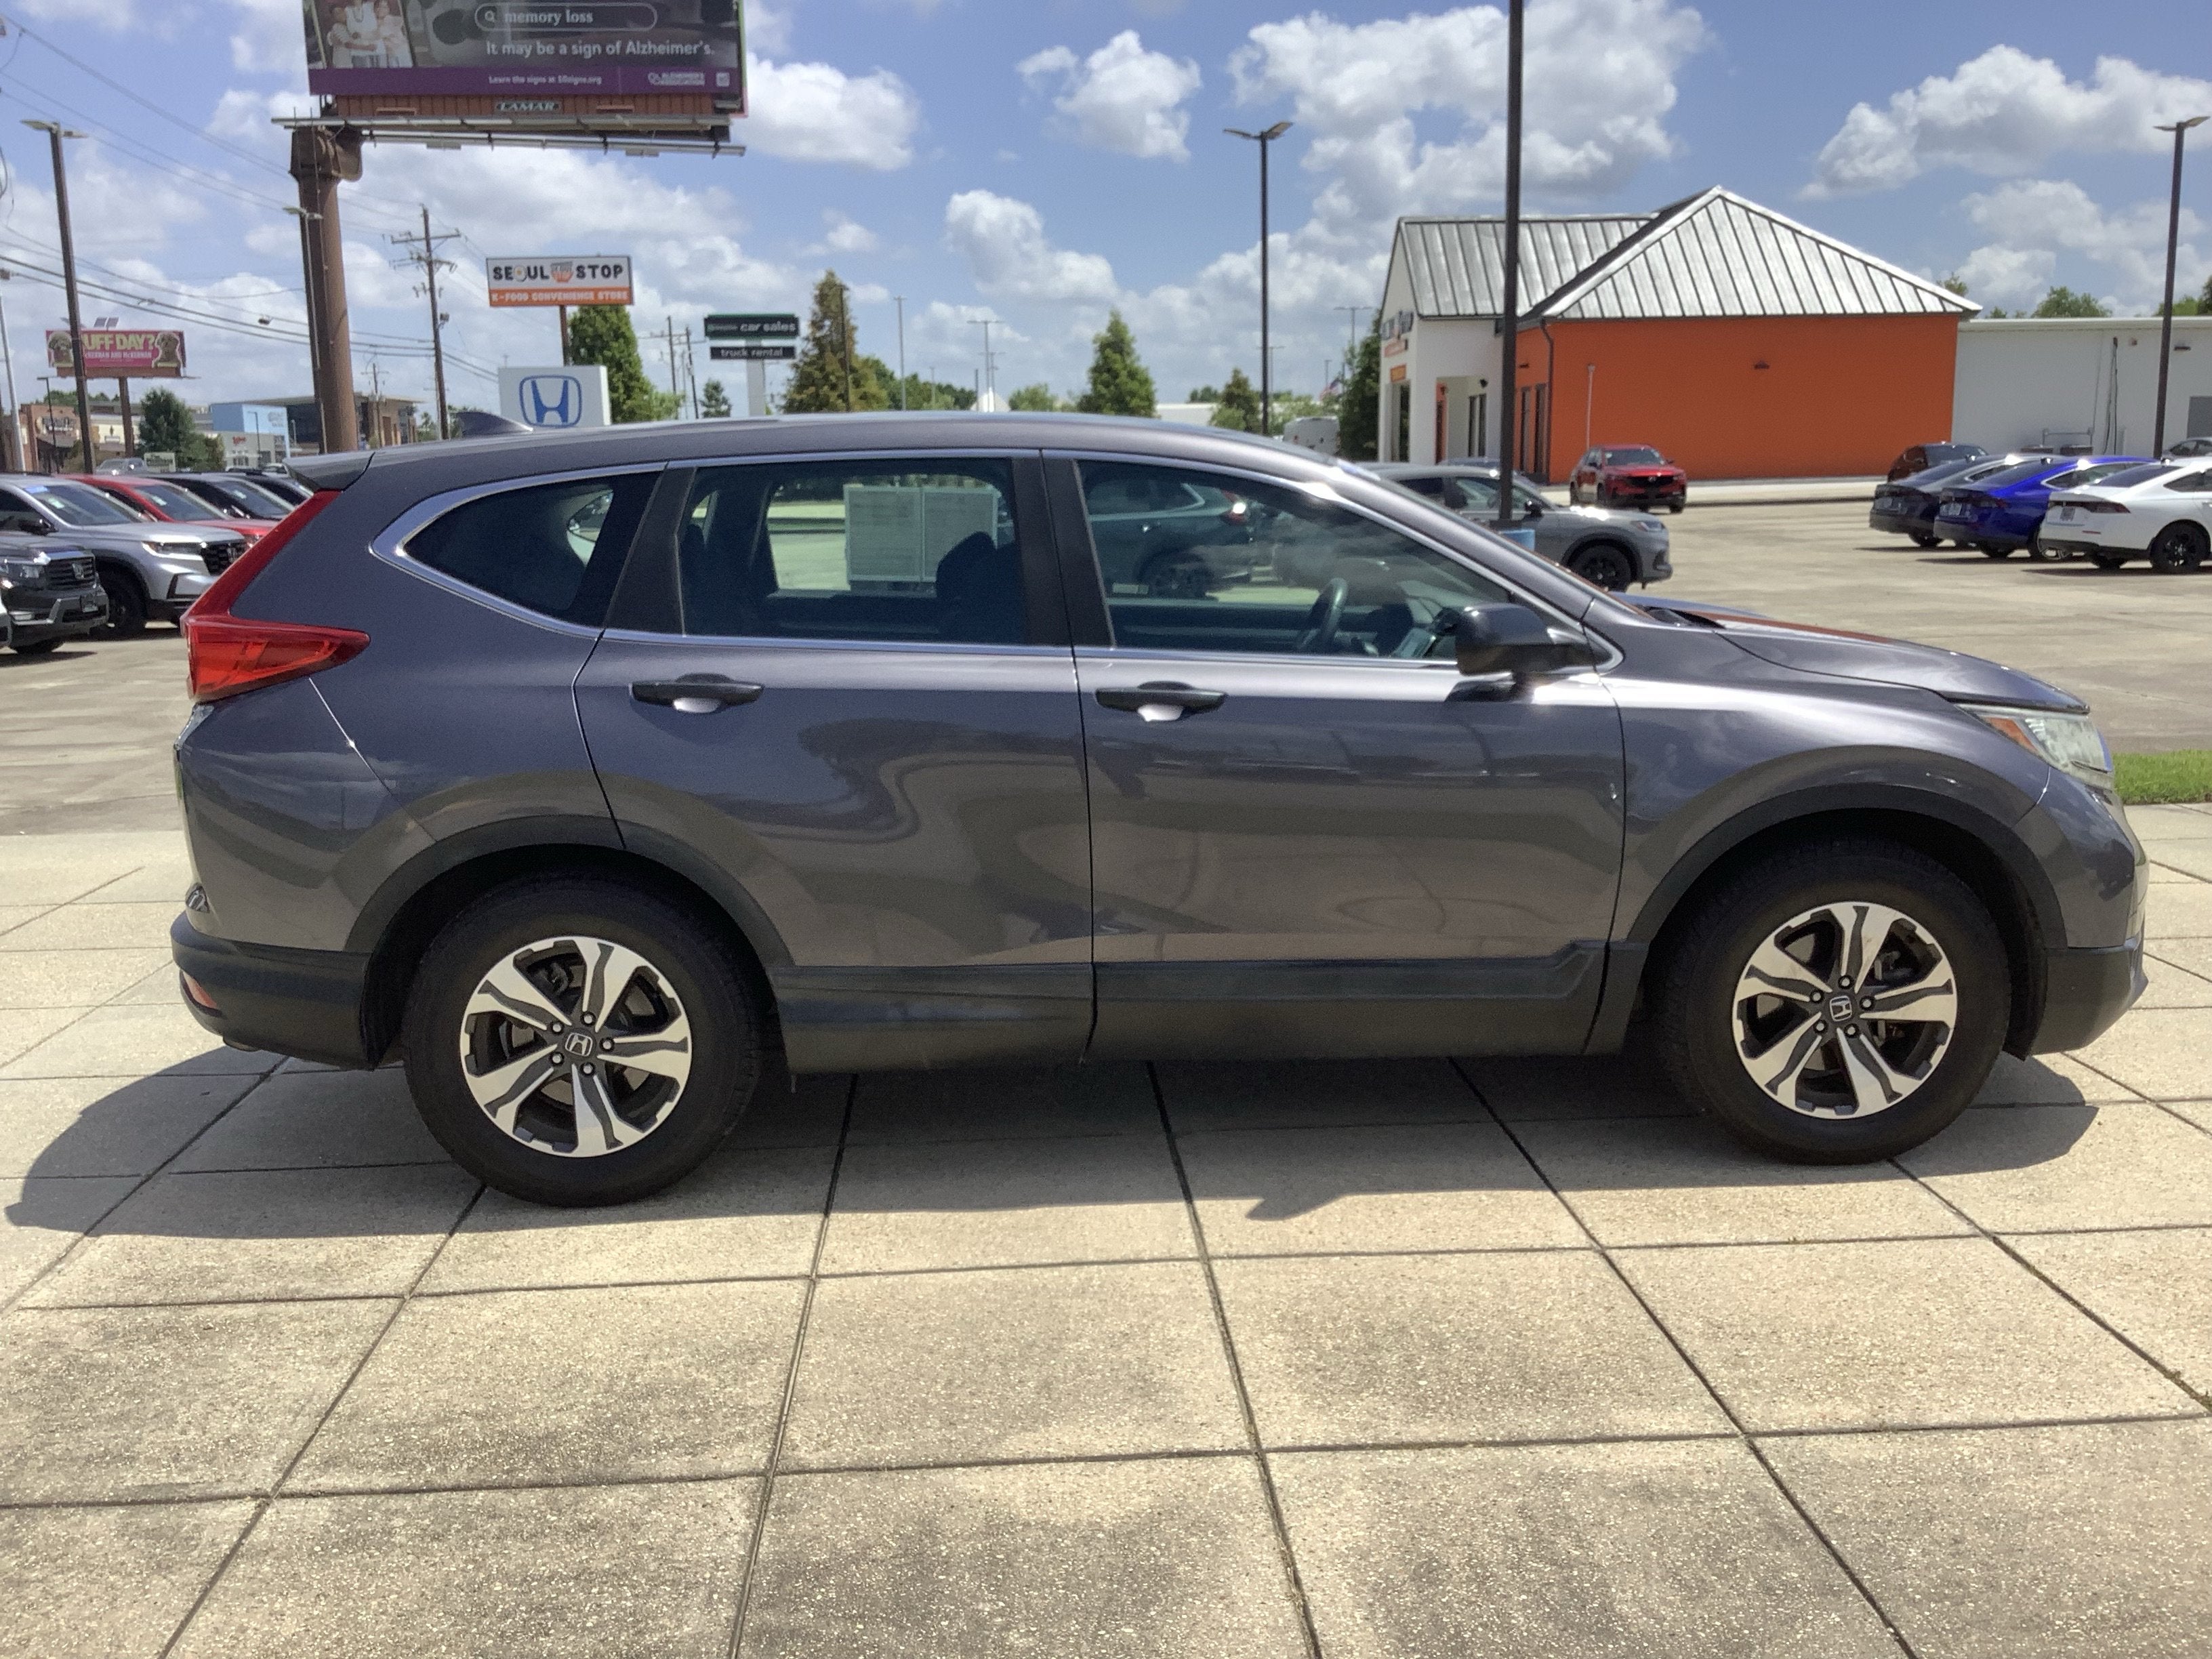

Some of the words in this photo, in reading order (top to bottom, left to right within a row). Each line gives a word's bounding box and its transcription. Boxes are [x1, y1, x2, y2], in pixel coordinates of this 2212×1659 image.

[504, 12, 562, 26] memory
[566, 9, 594, 24] loss
[486, 41, 499, 55] It
[502, 43, 533, 58] may
[536, 41, 555, 55] be
[559, 43, 567, 55] a
[571, 40, 602, 59] sign
[605, 39, 622, 55] of
[499, 101, 556, 112] LAMAR
[576, 264, 623, 279] STOP
[739, 323, 761, 331] car
[763, 321, 796, 331] sales
[82, 333, 114, 350] UFF
[116, 333, 155, 350] DAY?
[720, 348, 748, 357] truck
[750, 348, 783, 357] rental
